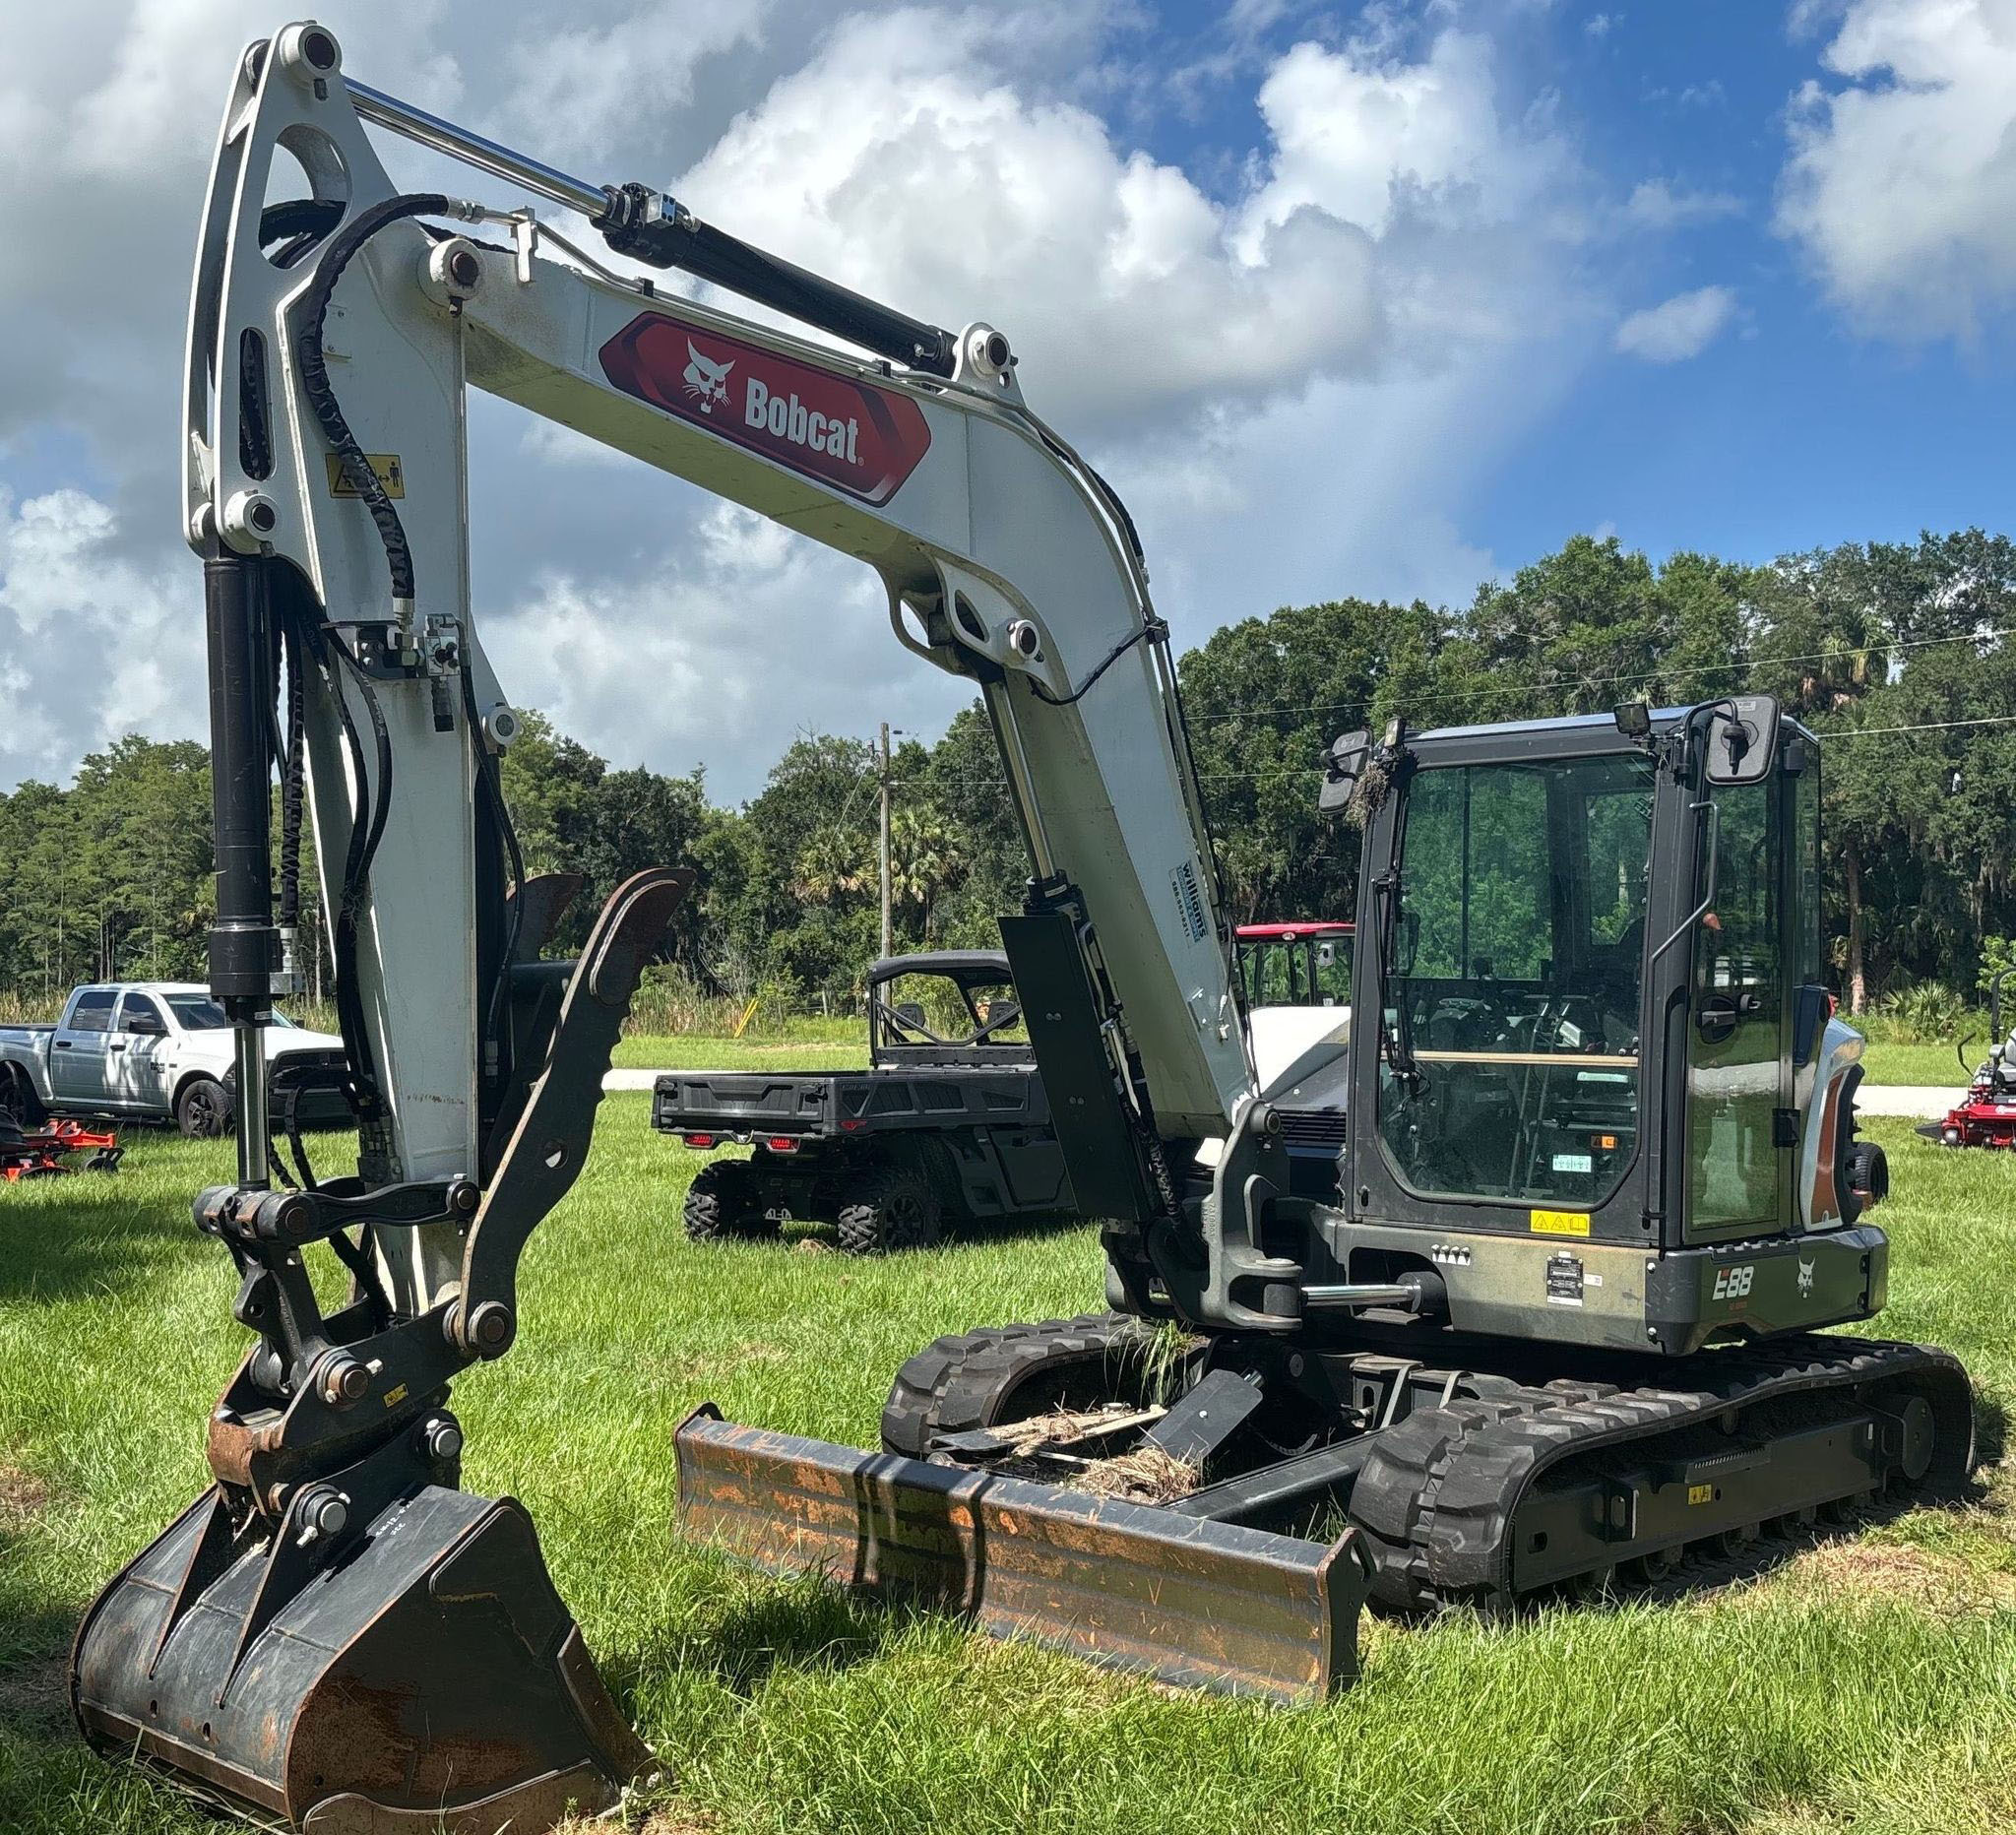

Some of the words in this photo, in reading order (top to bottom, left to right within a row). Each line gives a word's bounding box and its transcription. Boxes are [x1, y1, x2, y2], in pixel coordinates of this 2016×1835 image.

[745, 376, 858, 464] Bobcat
[1182, 862, 1207, 938] williams
[1712, 1266, 1755, 1300] E88
